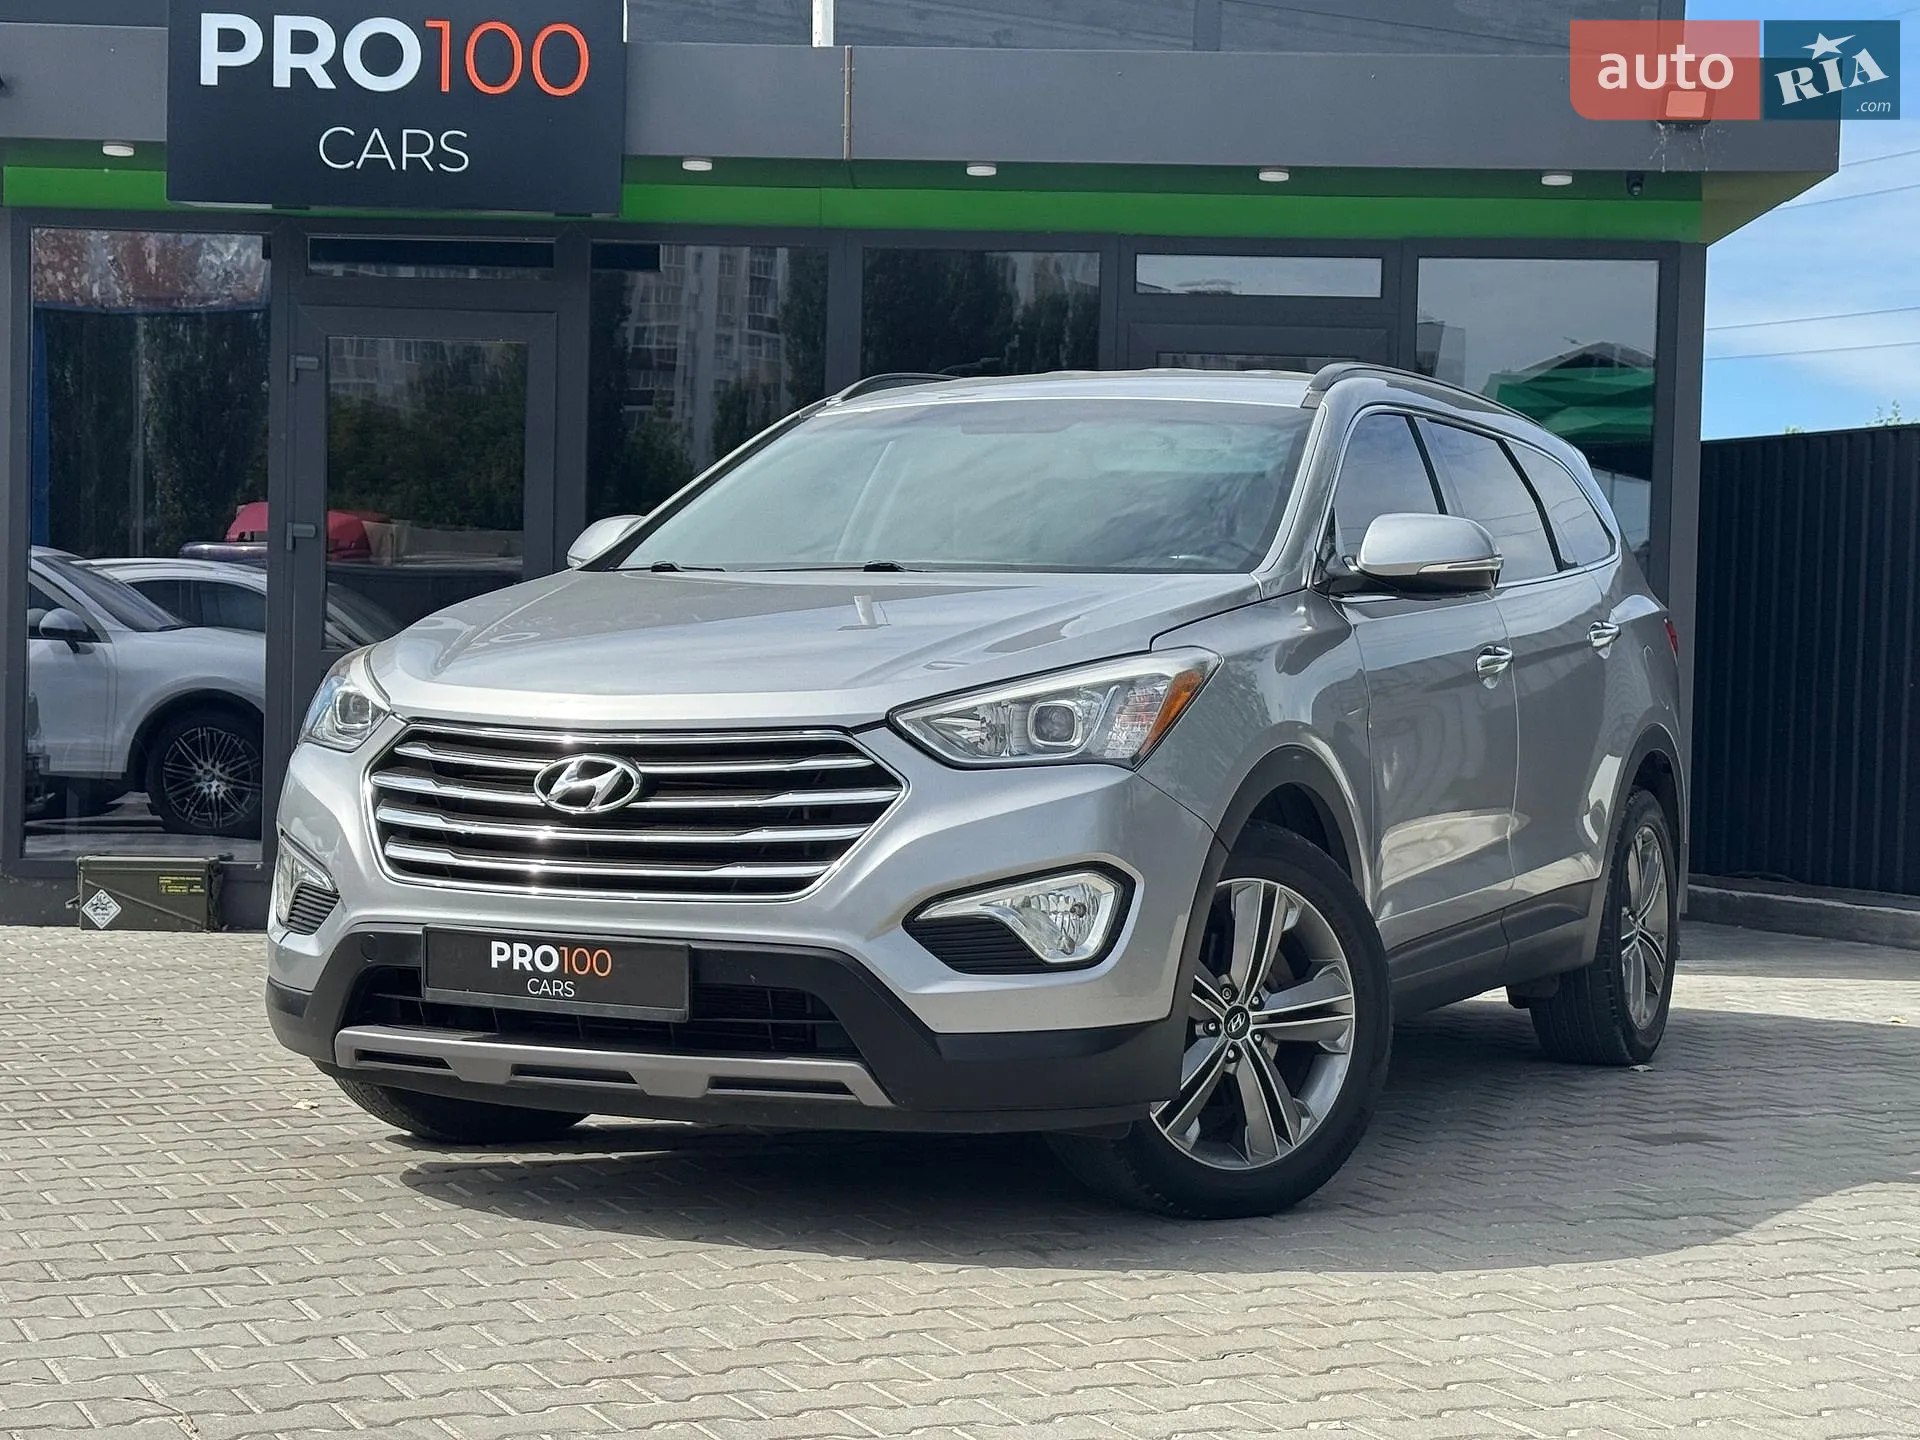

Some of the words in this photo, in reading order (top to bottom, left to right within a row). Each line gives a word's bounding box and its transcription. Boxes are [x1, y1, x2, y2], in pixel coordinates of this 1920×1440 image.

[199, 11, 591, 97] PRO100
[318, 125, 470, 173] CARS
[490, 940, 613, 977] PRO100
[526, 978, 575, 998] CARS
